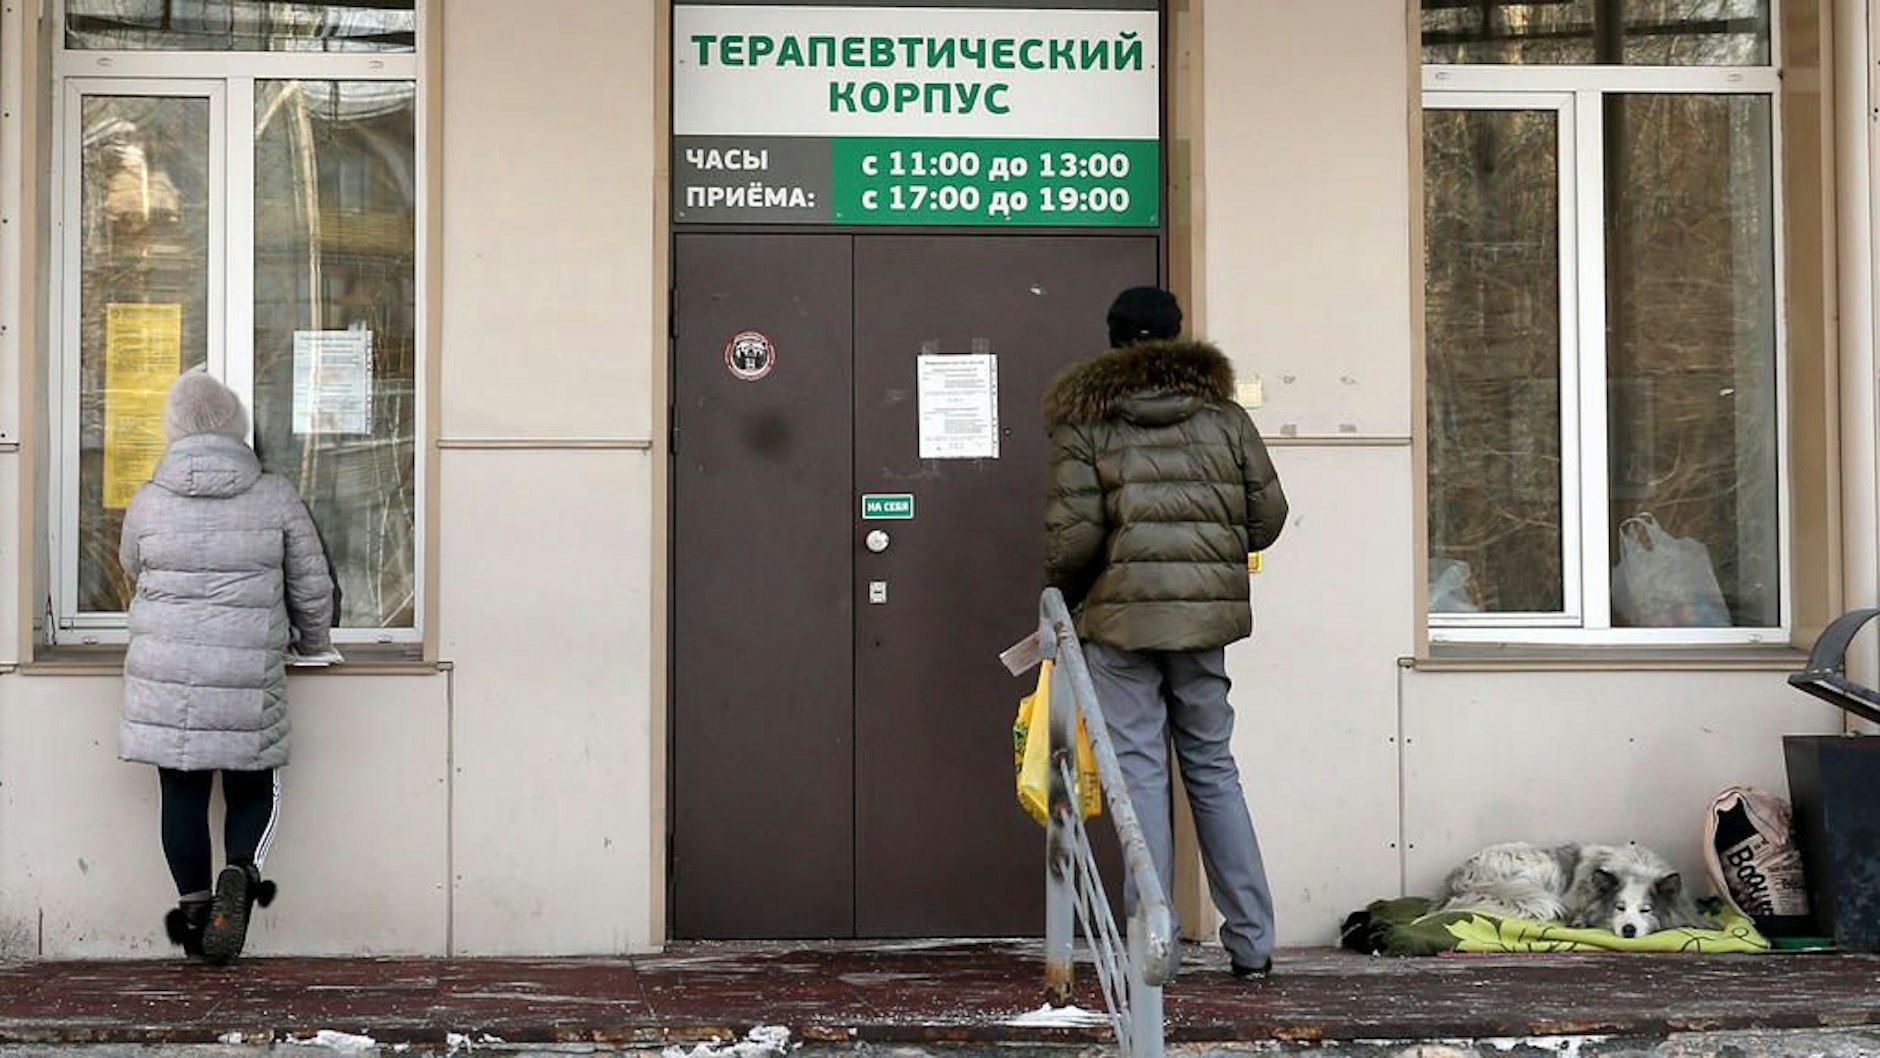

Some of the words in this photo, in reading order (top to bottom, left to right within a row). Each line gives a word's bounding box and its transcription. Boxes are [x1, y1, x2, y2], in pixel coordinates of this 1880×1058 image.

[691, 32, 1143, 71] ТЕРАПЕВТИЧЕСКИЙ
[828, 81, 1010, 114] КОРПУС
[685, 148, 769, 171] ЧАСЫ
[862, 155, 878, 176] с
[890, 151, 980, 177] 11:00
[988, 157, 1028, 182] до
[1040, 152, 1130, 178] 13:00
[686, 181, 815, 208] ПРИЁМА:
[862, 190, 878, 210] с
[890, 185, 980, 211] 17:00
[988, 191, 1028, 216] до
[1040, 187, 1130, 212] 19:00
[867, 502, 882, 512] НА
[883, 502, 909, 512] СЕБЯ
